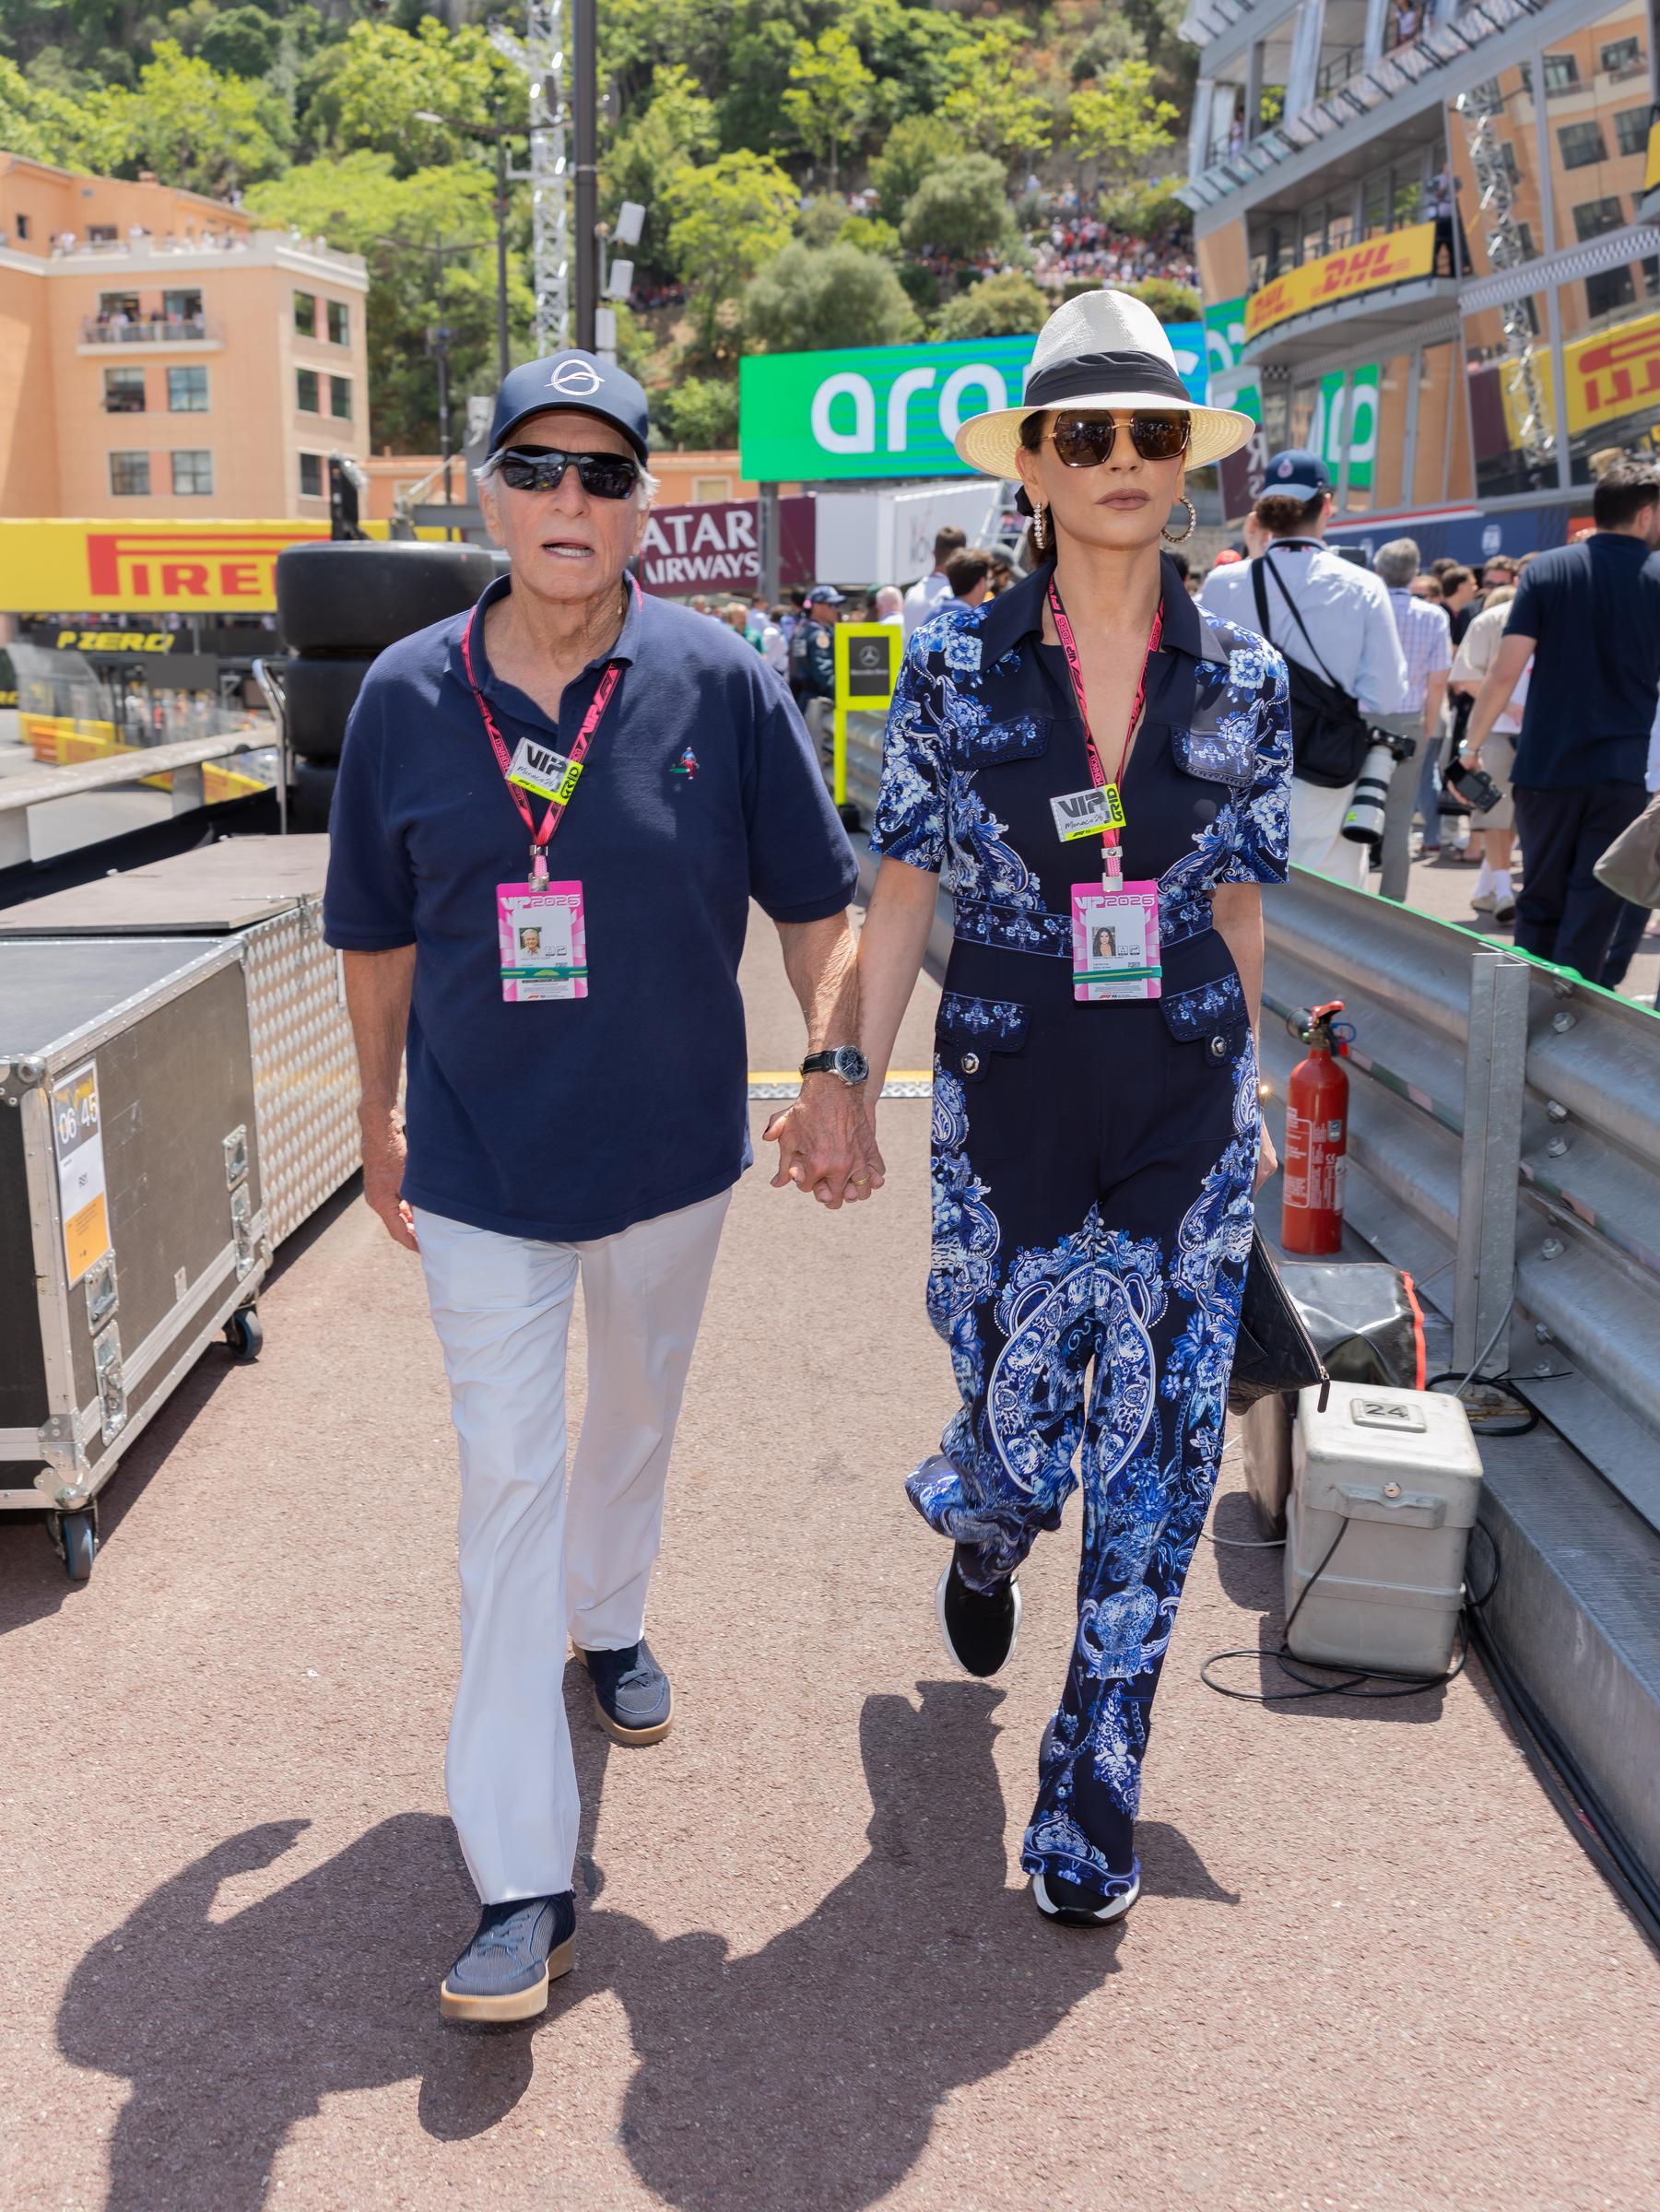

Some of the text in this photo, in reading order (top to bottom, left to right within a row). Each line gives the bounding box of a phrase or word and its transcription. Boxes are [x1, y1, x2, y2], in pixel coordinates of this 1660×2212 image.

[1324, 242, 1391, 293] DHL
[642, 510, 757, 555] ATAR
[527, 745, 568, 775] VIP
[1057, 791, 1106, 818] VIP
[1106, 787, 1123, 822] GRID
[59, 1107, 77, 1145] 06
[1365, 1404, 1408, 1418] 24
